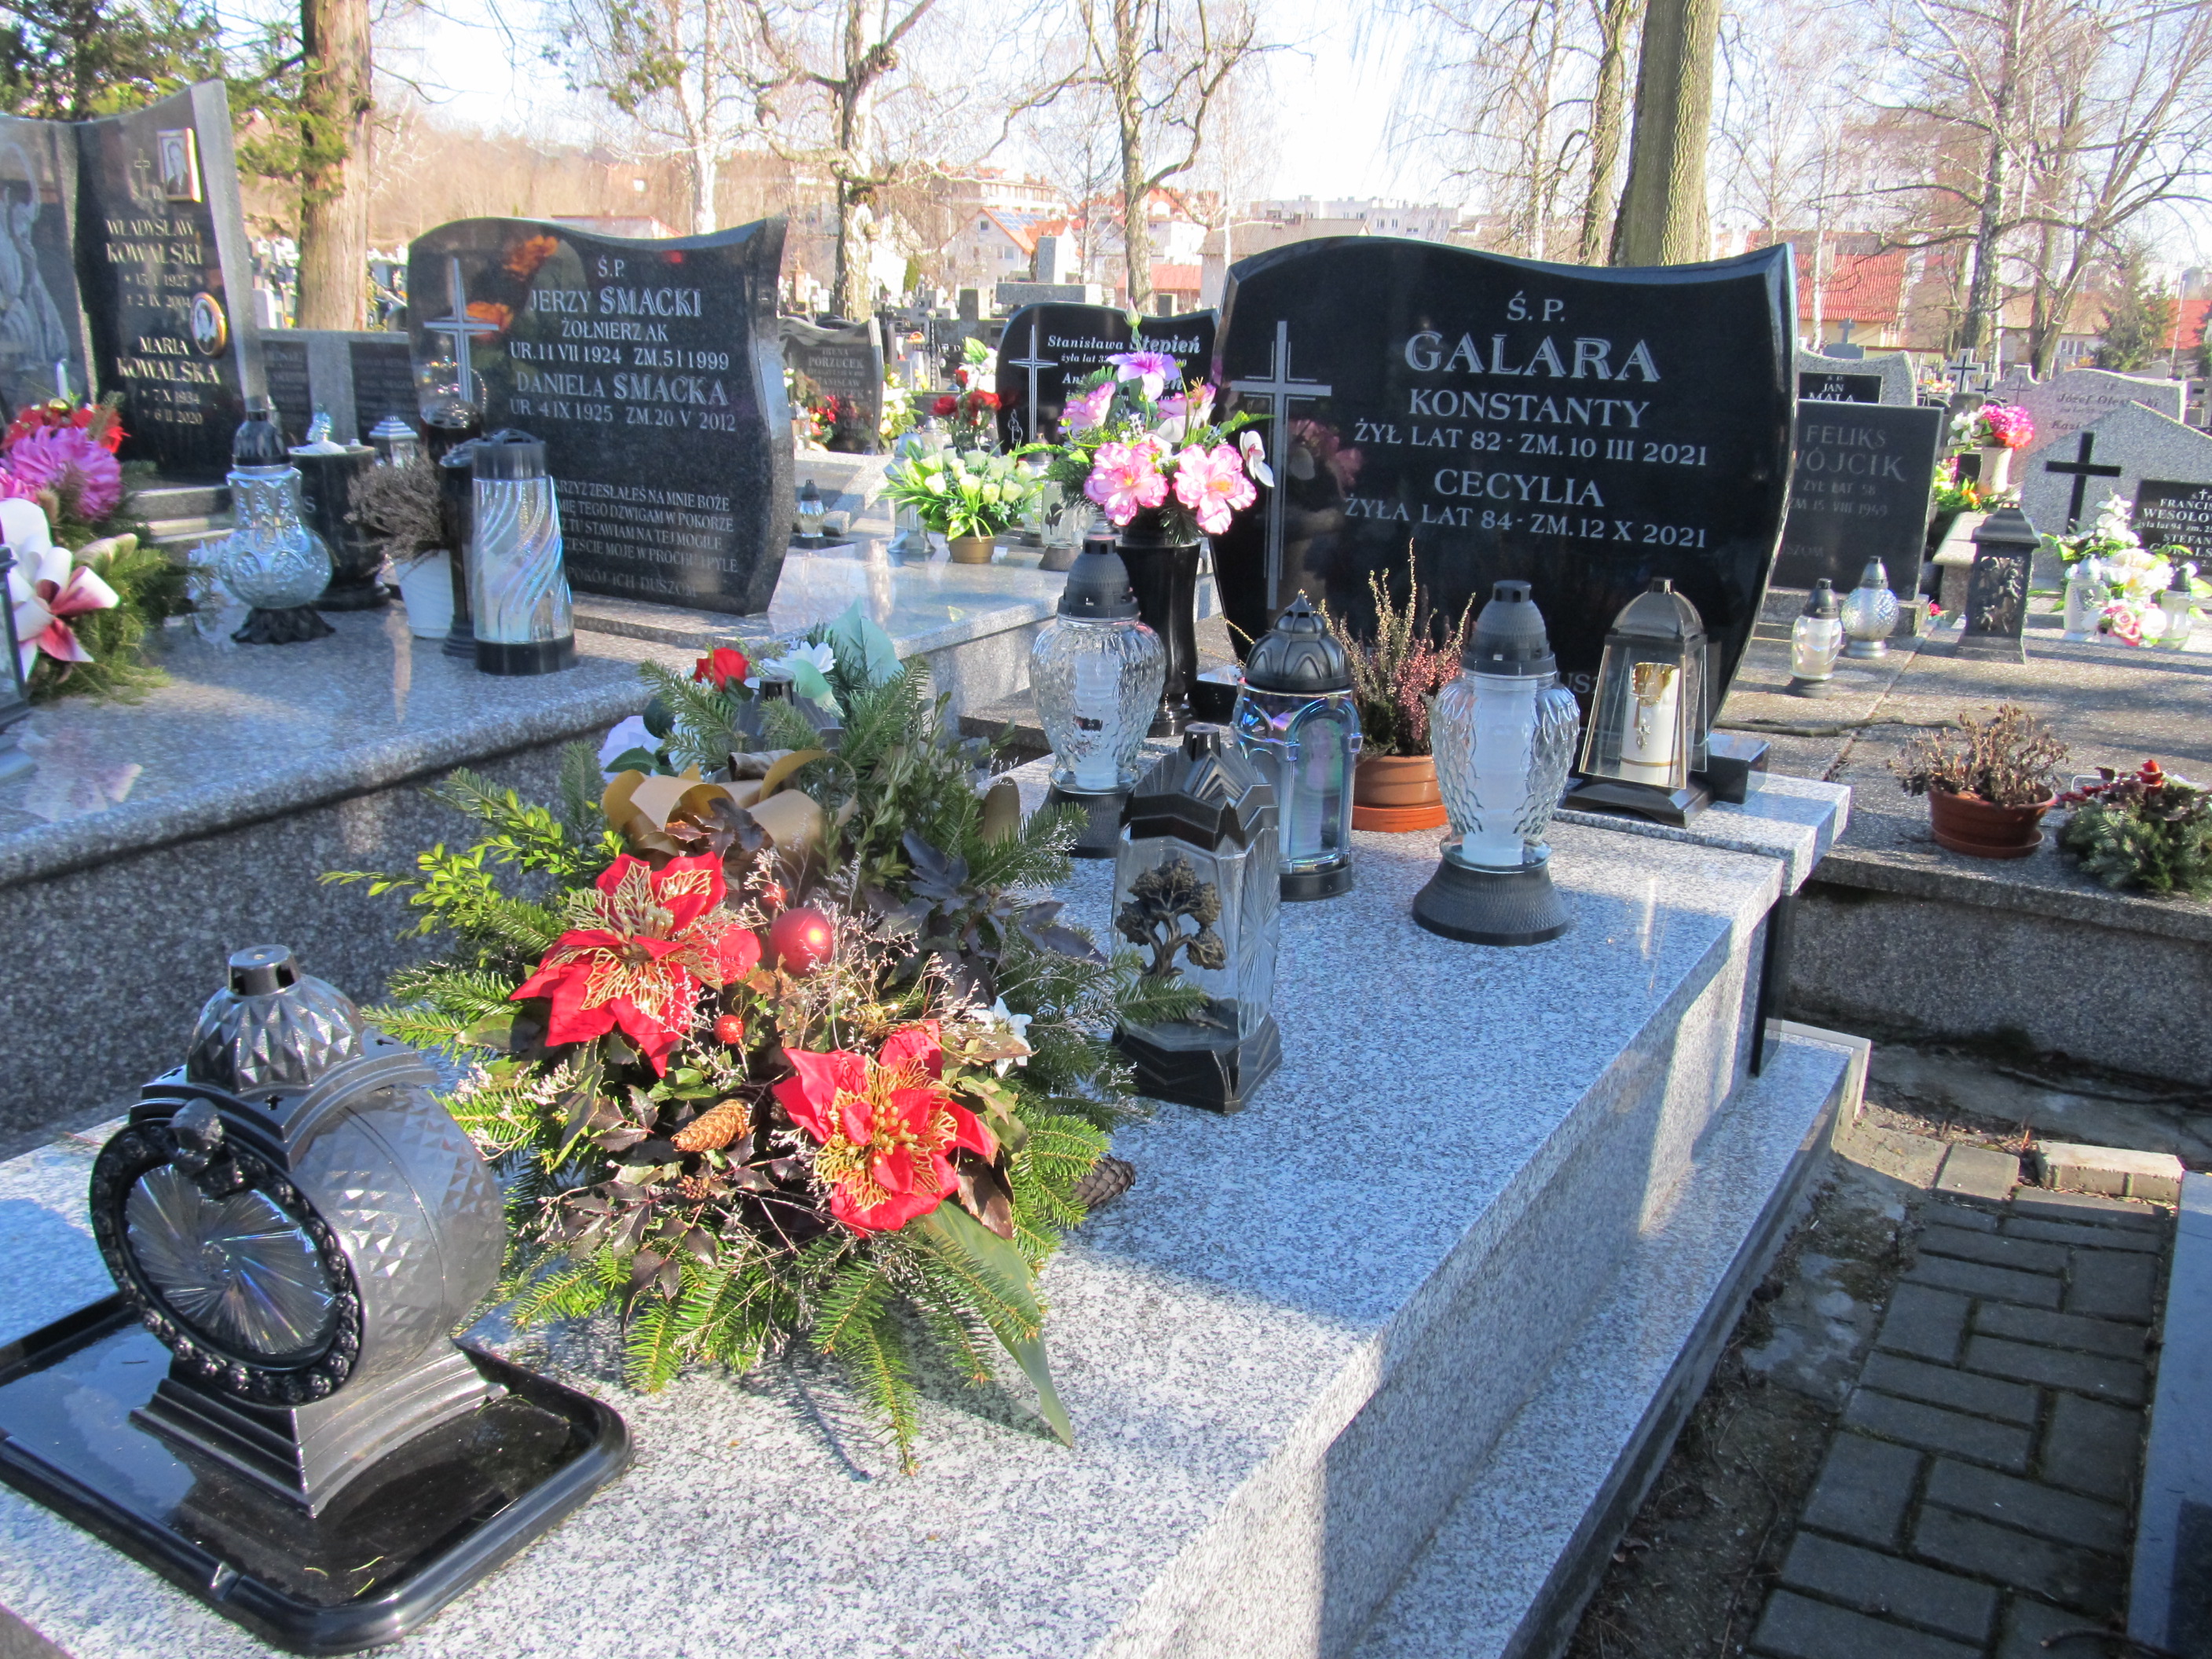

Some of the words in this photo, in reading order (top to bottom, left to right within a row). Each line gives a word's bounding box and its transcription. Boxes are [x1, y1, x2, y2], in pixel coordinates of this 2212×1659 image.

[105, 242, 203, 266] KOWALSKI
[530, 288, 591, 313] JERZY
[599, 285, 703, 317] SMACKI
[561, 317, 642, 340] ŻOŁNIERZ
[646, 323, 668, 342] AK
[1047, 335, 1124, 350] Stanisława
[138, 335, 190, 356] MARIA
[558, 343, 579, 362] VII
[584, 346, 622, 364] 1924
[687, 351, 730, 371] 1999
[1060, 353, 1080, 364] żyła
[1082, 353, 1096, 363] lat
[1404, 330, 1661, 383] GALARA
[116, 357, 221, 385] KOWALSKA
[818, 376, 861, 387] TANISŁAW
[516, 371, 606, 398] DANIELA
[613, 372, 730, 407] SMACKA
[1822, 383, 1844, 394] JAN
[2056, 393, 2093, 405] Józef
[176, 410, 204, 425] 2020
[552, 401, 572, 419] IX
[575, 402, 613, 423] 1925
[679, 408, 692, 428] V
[699, 412, 737, 432] 2012
[1408, 388, 1650, 428] KONSTANTY
[1353, 417, 1403, 445] ŻYŁ
[1411, 426, 1463, 448] LAT
[1470, 430, 1501, 452] 82
[1519, 433, 1564, 456] ZM.
[1569, 437, 1597, 458] 10
[1606, 438, 1635, 461] III
[1643, 442, 1707, 466] 2021
[1806, 424, 1887, 450] FELIKS
[647, 489, 665, 505] NA
[666, 491, 696, 508] MNIE
[697, 493, 731, 512] BOŻE
[1434, 468, 1605, 507] CECYLIA
[1831, 481, 1854, 494] LAT
[577, 500, 608, 517] TEGO
[665, 511, 676, 524] W
[678, 511, 734, 533] POKORZE
[1344, 493, 1411, 522] ŻYŁA
[1421, 504, 1474, 527] LAT
[1481, 510, 1513, 531] 84
[1529, 513, 1574, 537] ZM.
[1579, 518, 1605, 539] 12
[1612, 520, 1634, 542] X
[1643, 524, 1706, 548] 2021
[2143, 507, 2212, 523] WESOŁO
[584, 520, 635, 540] STAWIAM
[635, 526, 653, 542] NA
[676, 532, 723, 551] MOGILE
[2163, 533, 2212, 545] STEFAN
[606, 542, 635, 559] MOJE
[636, 546, 646, 559] W
[706, 556, 739, 573] PYLE
